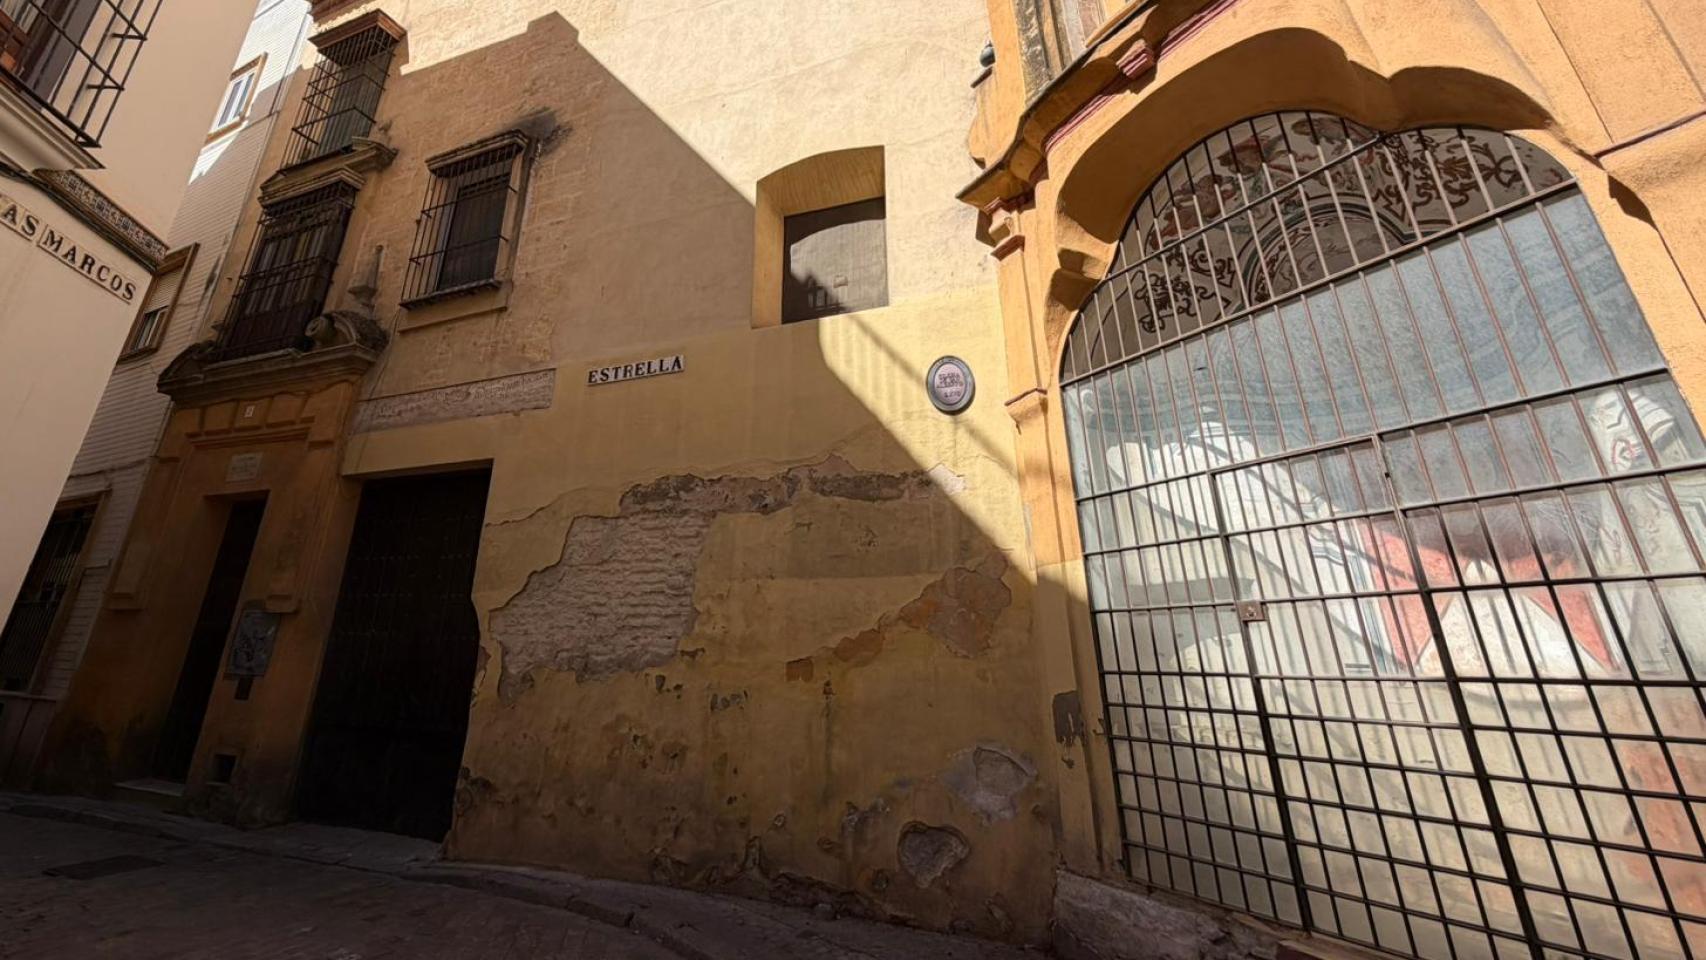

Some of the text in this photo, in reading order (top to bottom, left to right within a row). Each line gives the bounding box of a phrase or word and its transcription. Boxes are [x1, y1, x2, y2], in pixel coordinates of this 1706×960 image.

[0, 194, 137, 301] AS MARCOS
[588, 355, 682, 384] ESTRELLA
